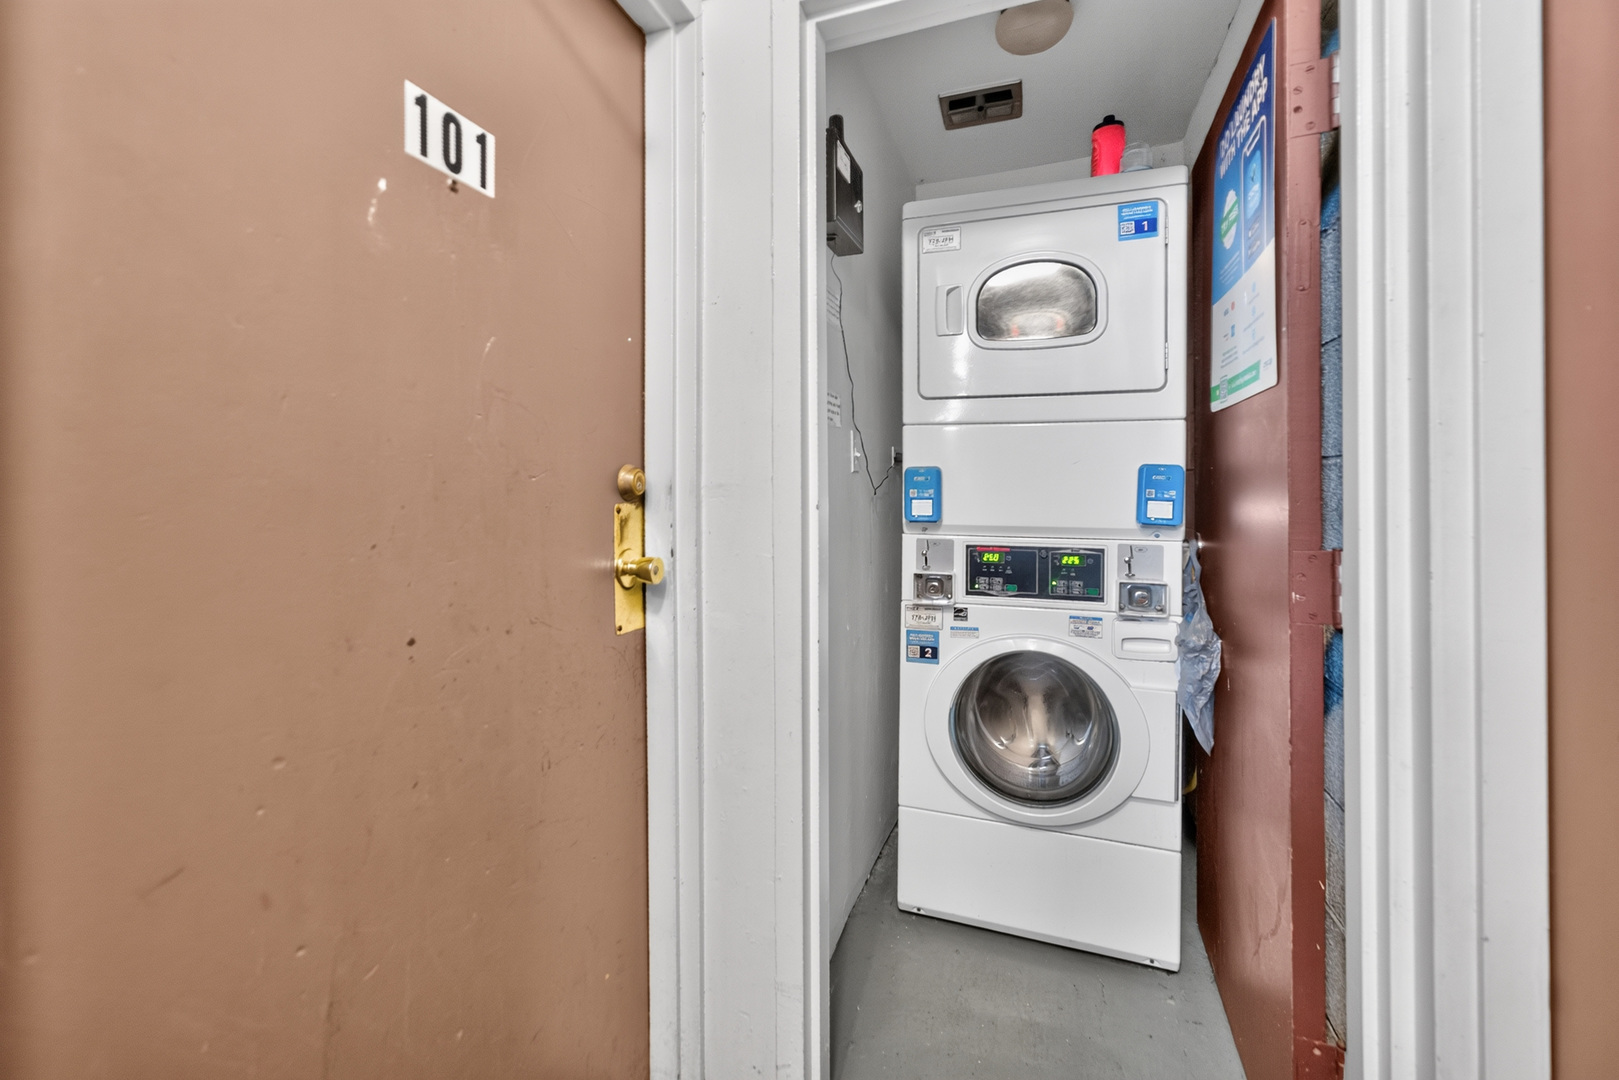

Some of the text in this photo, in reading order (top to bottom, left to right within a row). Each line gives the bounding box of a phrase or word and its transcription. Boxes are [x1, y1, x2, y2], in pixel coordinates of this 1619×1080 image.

[1219, 76, 1268, 180] WITH THE APP
[1229, 53, 1266, 139] LAUNDRY
[415, 94, 487, 190] 101
[1141, 220, 1149, 231] 1
[924, 647, 933, 658] 2
